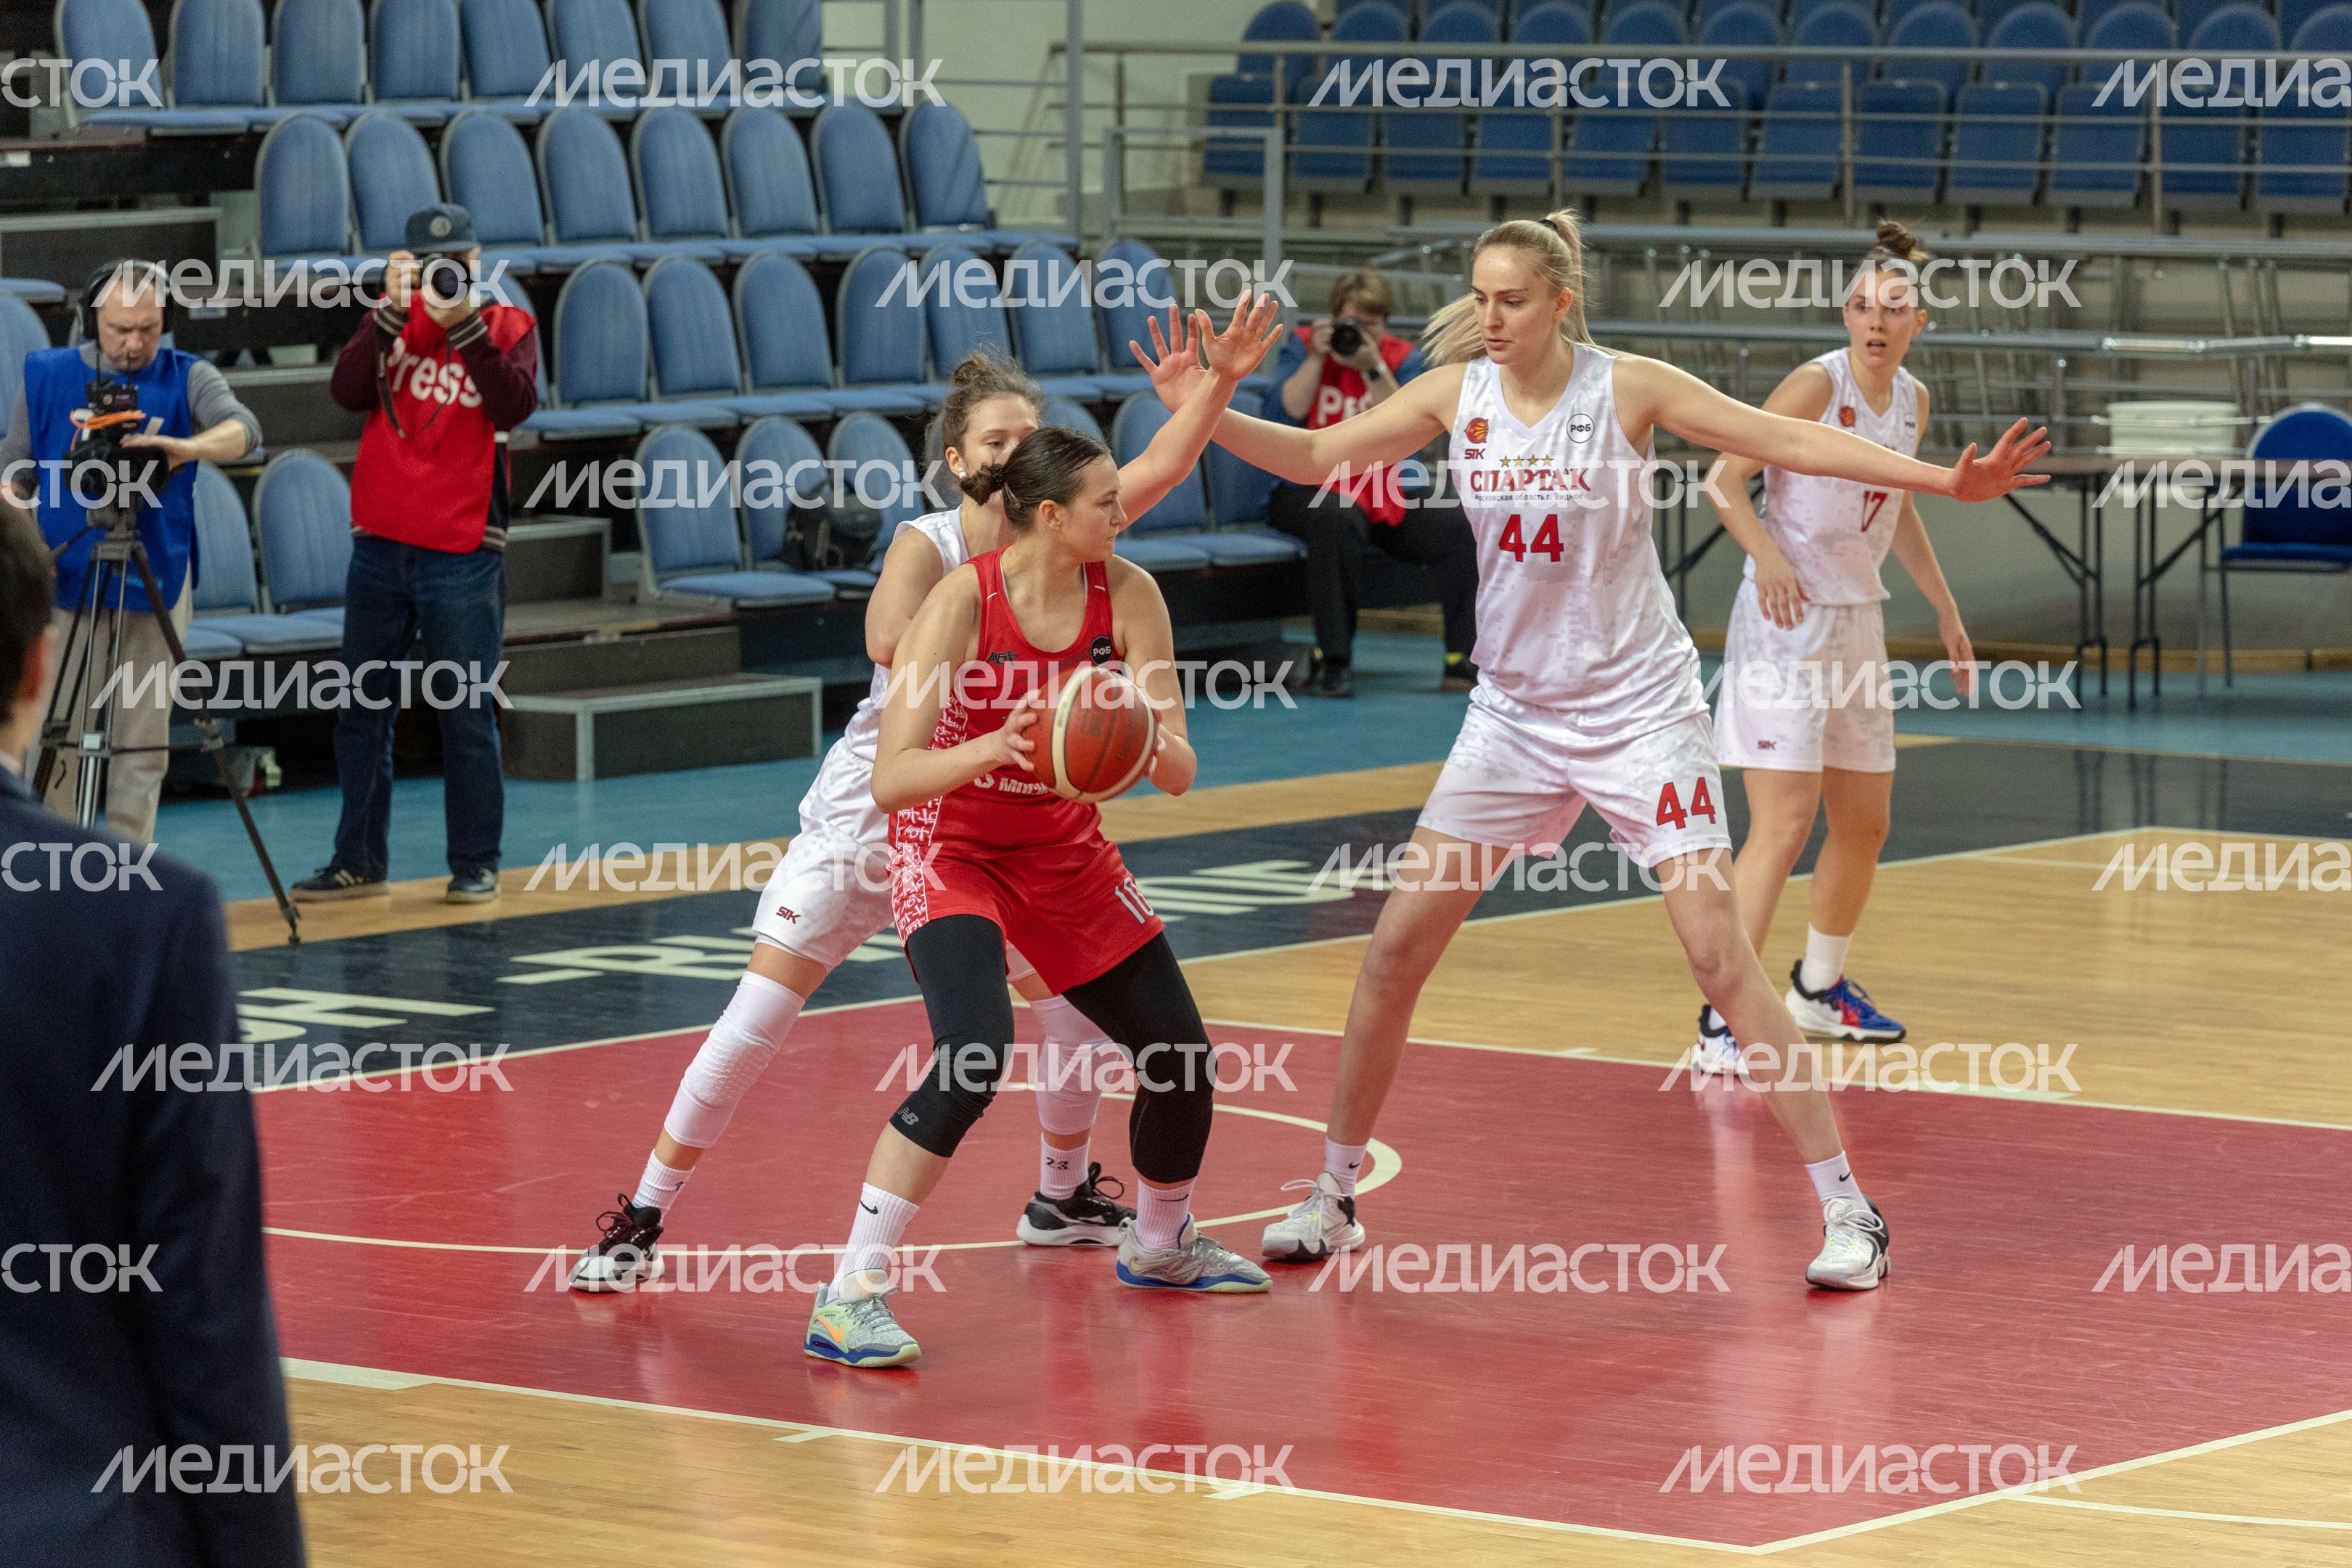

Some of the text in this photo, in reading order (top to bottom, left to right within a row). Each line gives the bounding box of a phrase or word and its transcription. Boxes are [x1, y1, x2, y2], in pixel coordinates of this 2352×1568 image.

[1570, 424, 1591, 433] РФБ
[1860, 490, 1889, 532] 17
[1498, 514, 1564, 562] 44
[1093, 645, 1111, 657] РФБ
[1656, 777, 1716, 830] 44
[776, 906, 801, 925] STK
